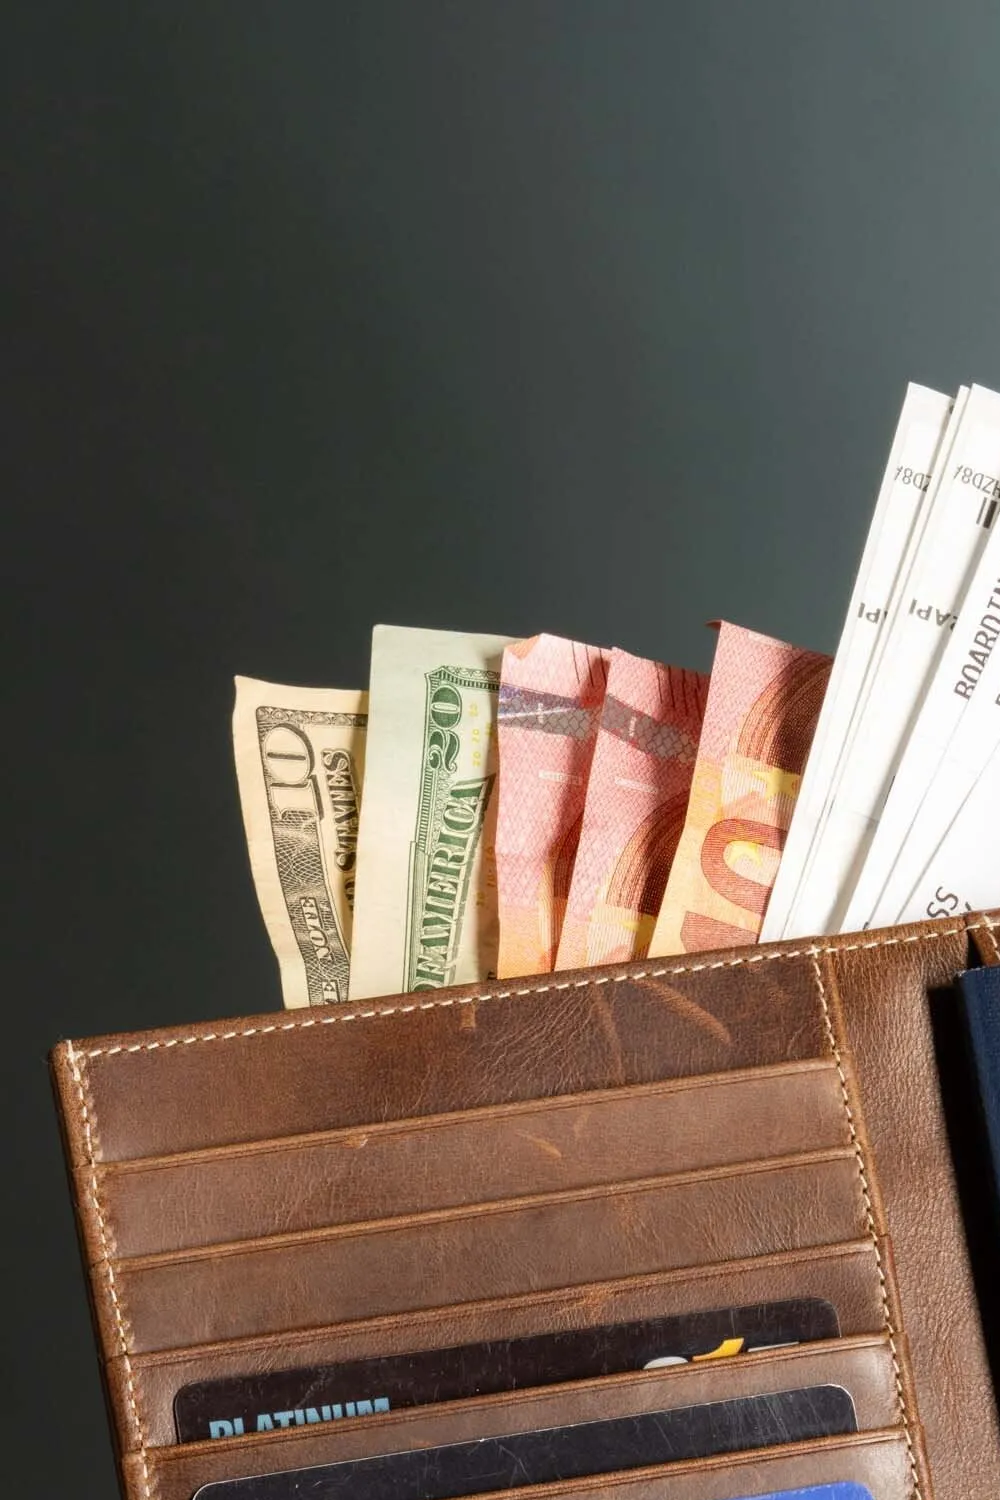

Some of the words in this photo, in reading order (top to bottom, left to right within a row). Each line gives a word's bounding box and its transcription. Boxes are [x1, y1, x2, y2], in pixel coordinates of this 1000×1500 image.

[262, 721, 325, 832] 10
[428, 683, 463, 774] 20
[418, 776, 492, 956] AMERICA
[299, 895, 335, 961] NOTE
